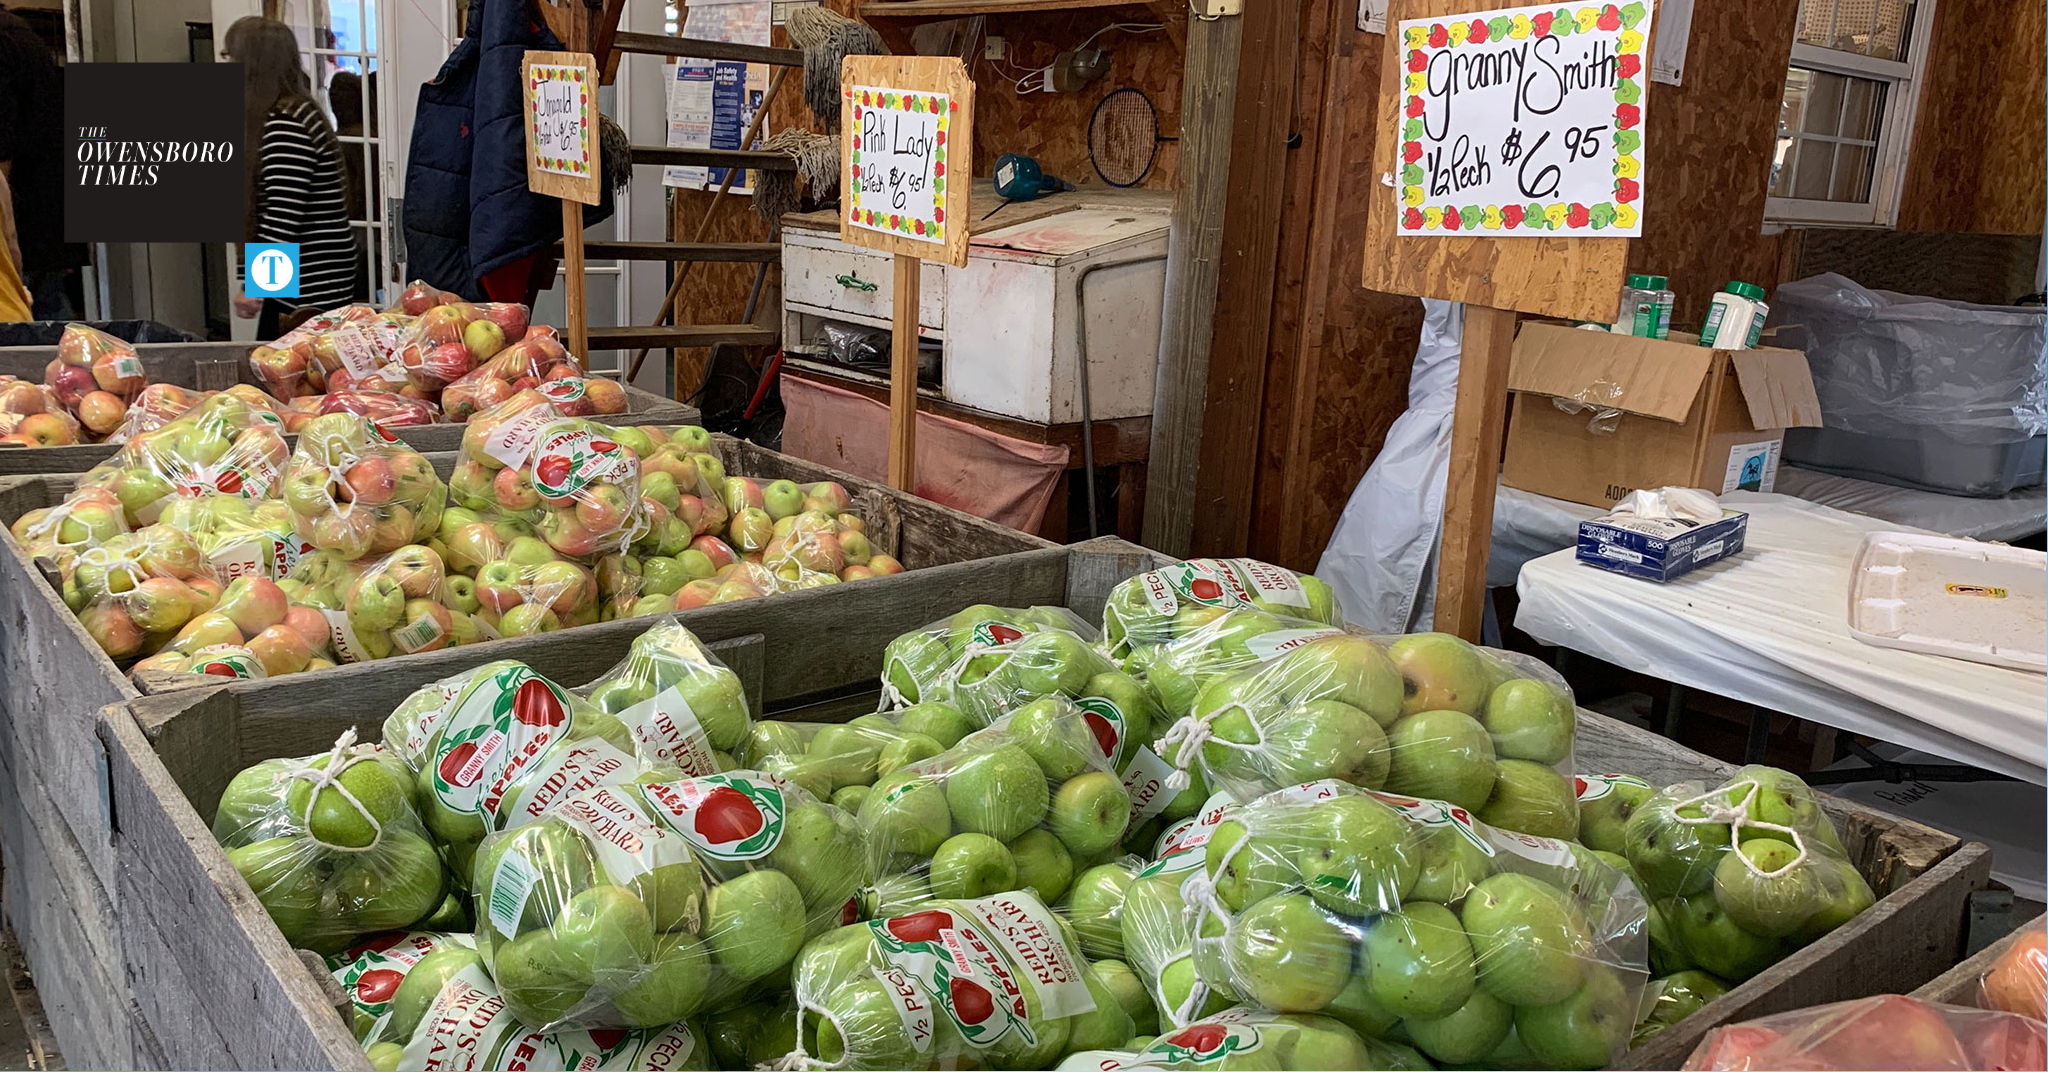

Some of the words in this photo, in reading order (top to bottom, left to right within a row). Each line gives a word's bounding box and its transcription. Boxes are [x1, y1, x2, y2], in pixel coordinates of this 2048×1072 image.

[1523, 35, 1617, 115] Smith
[863, 110, 886, 153] Pink
[893, 114, 934, 189] Lady
[1451, 134, 1491, 193] Peck
[868, 162, 885, 194] Peck
[545, 429, 588, 452] APPLES
[1581, 523, 1622, 540] DISPOSABLE
[1647, 539, 1664, 550] 500
[460, 750, 485, 782] GRANNY
[480, 733, 502, 755] SMITH
[483, 731, 551, 816] APPLES
[526, 755, 582, 817] REID'S
[571, 799, 645, 854] ORCHARD
[943, 930, 960, 951] SMITH
[952, 949, 972, 975] GRANNY
[1004, 928, 1054, 986] REID'S
[960, 927, 1028, 1019] APPLES
